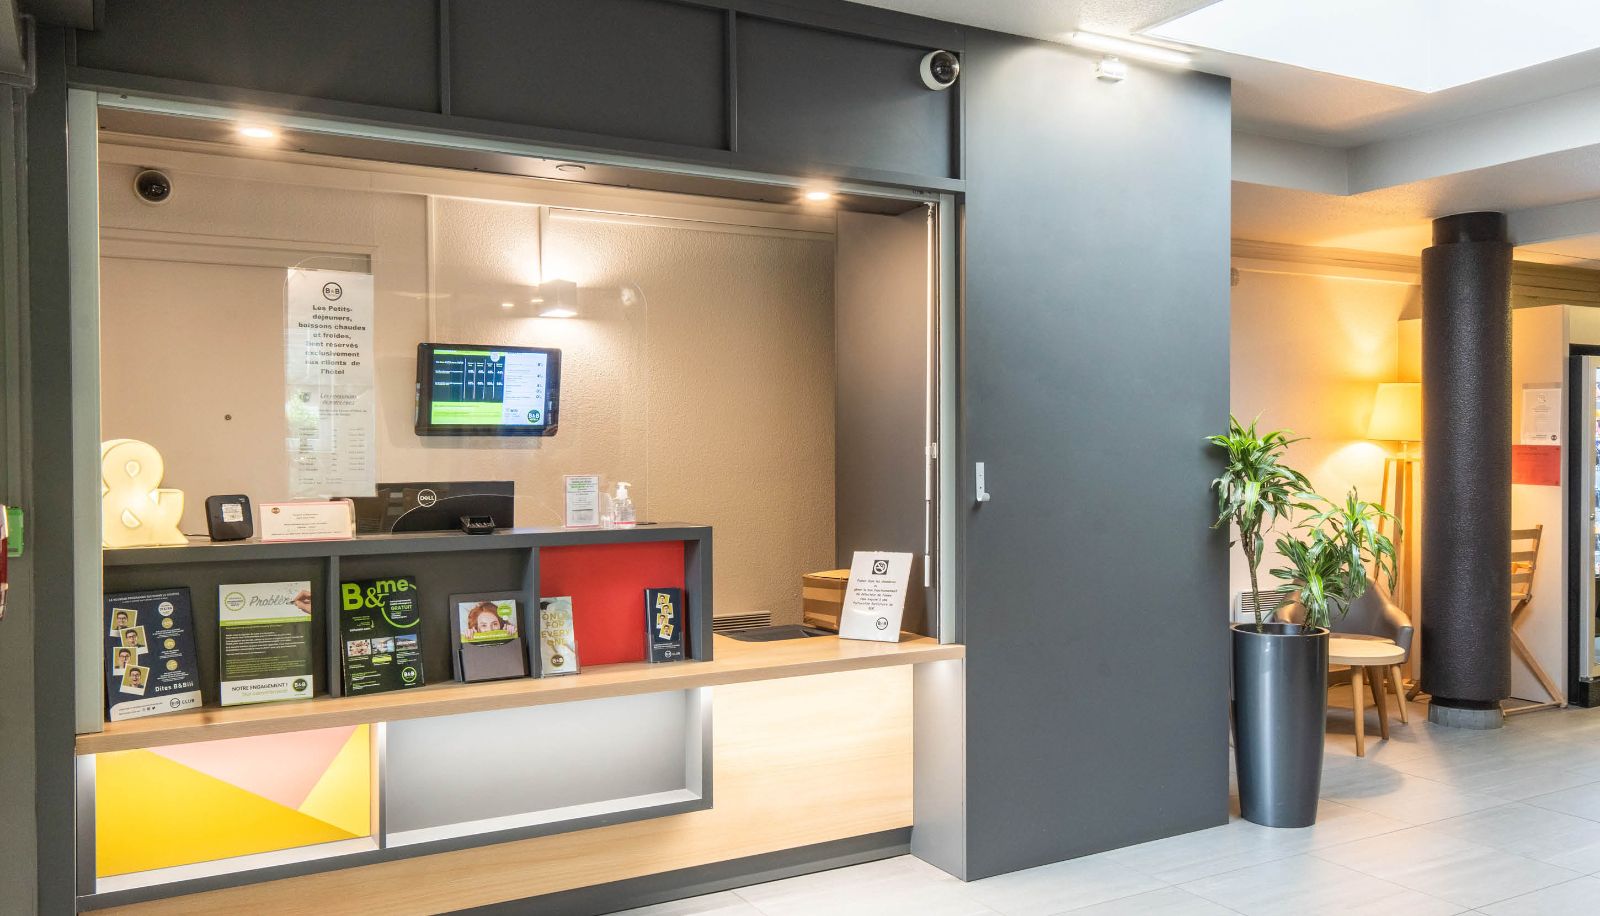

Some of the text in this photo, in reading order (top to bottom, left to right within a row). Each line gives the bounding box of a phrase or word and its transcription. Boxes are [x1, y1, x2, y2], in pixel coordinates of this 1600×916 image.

[328, 305, 353, 313] Petits-
[298, 322, 333, 330] boissons
[341, 579, 409, 611] B&me
